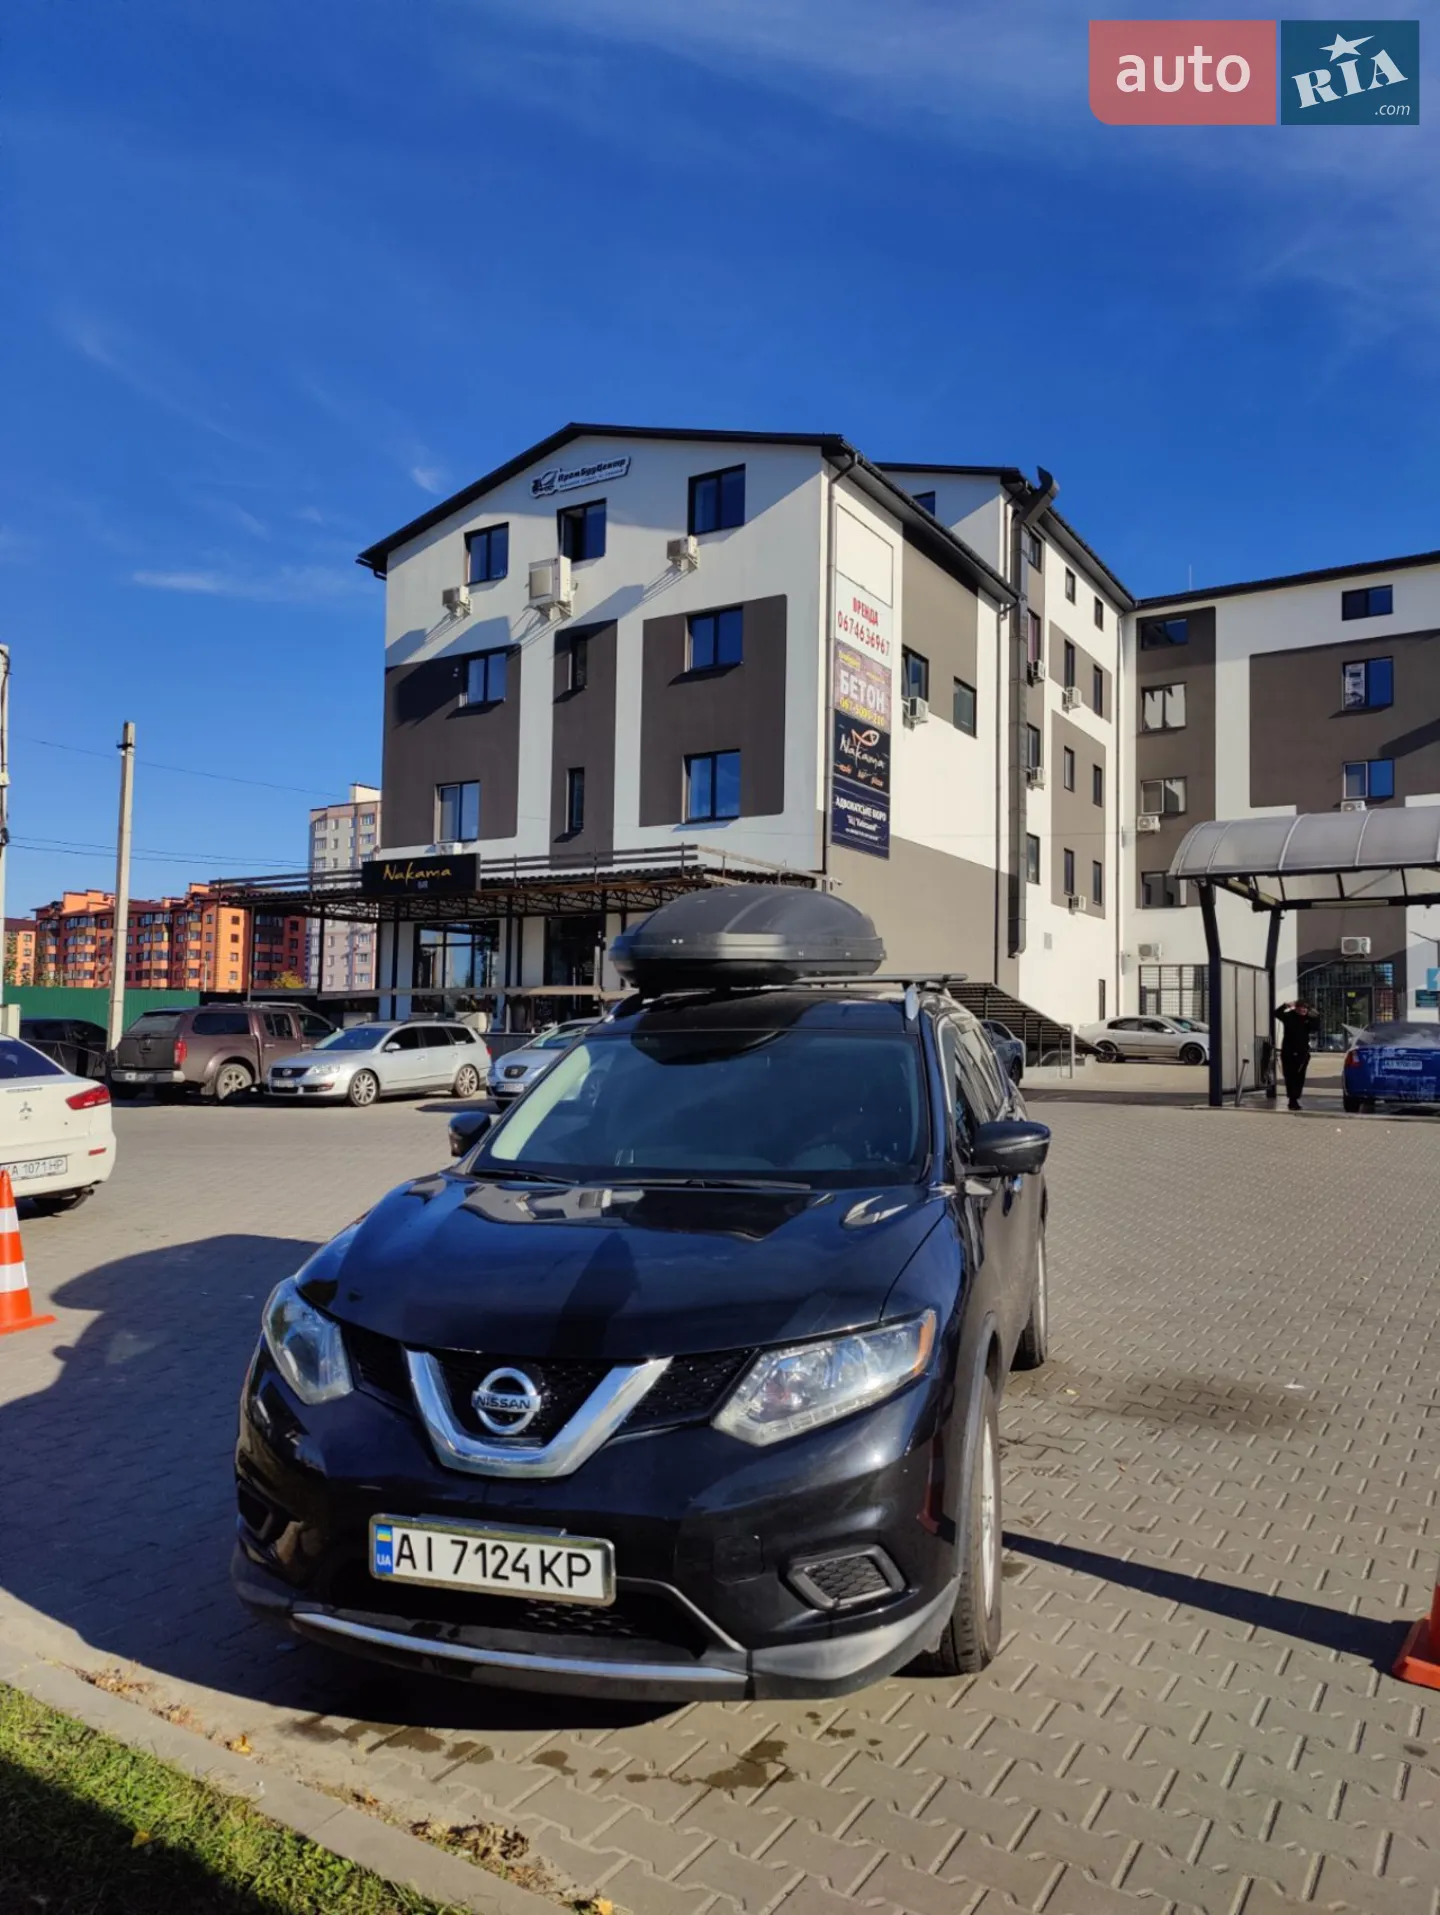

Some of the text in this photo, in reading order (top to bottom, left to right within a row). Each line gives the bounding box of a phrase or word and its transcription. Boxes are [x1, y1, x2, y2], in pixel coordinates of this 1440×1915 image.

[840, 669, 885, 714] БЕТОН
[382, 861, 452, 886] Nakama
[476, 1395, 531, 1410] NISSAN
[376, 1553, 392, 1566] UA
[395, 1533, 592, 1589] AI 7124 KP
